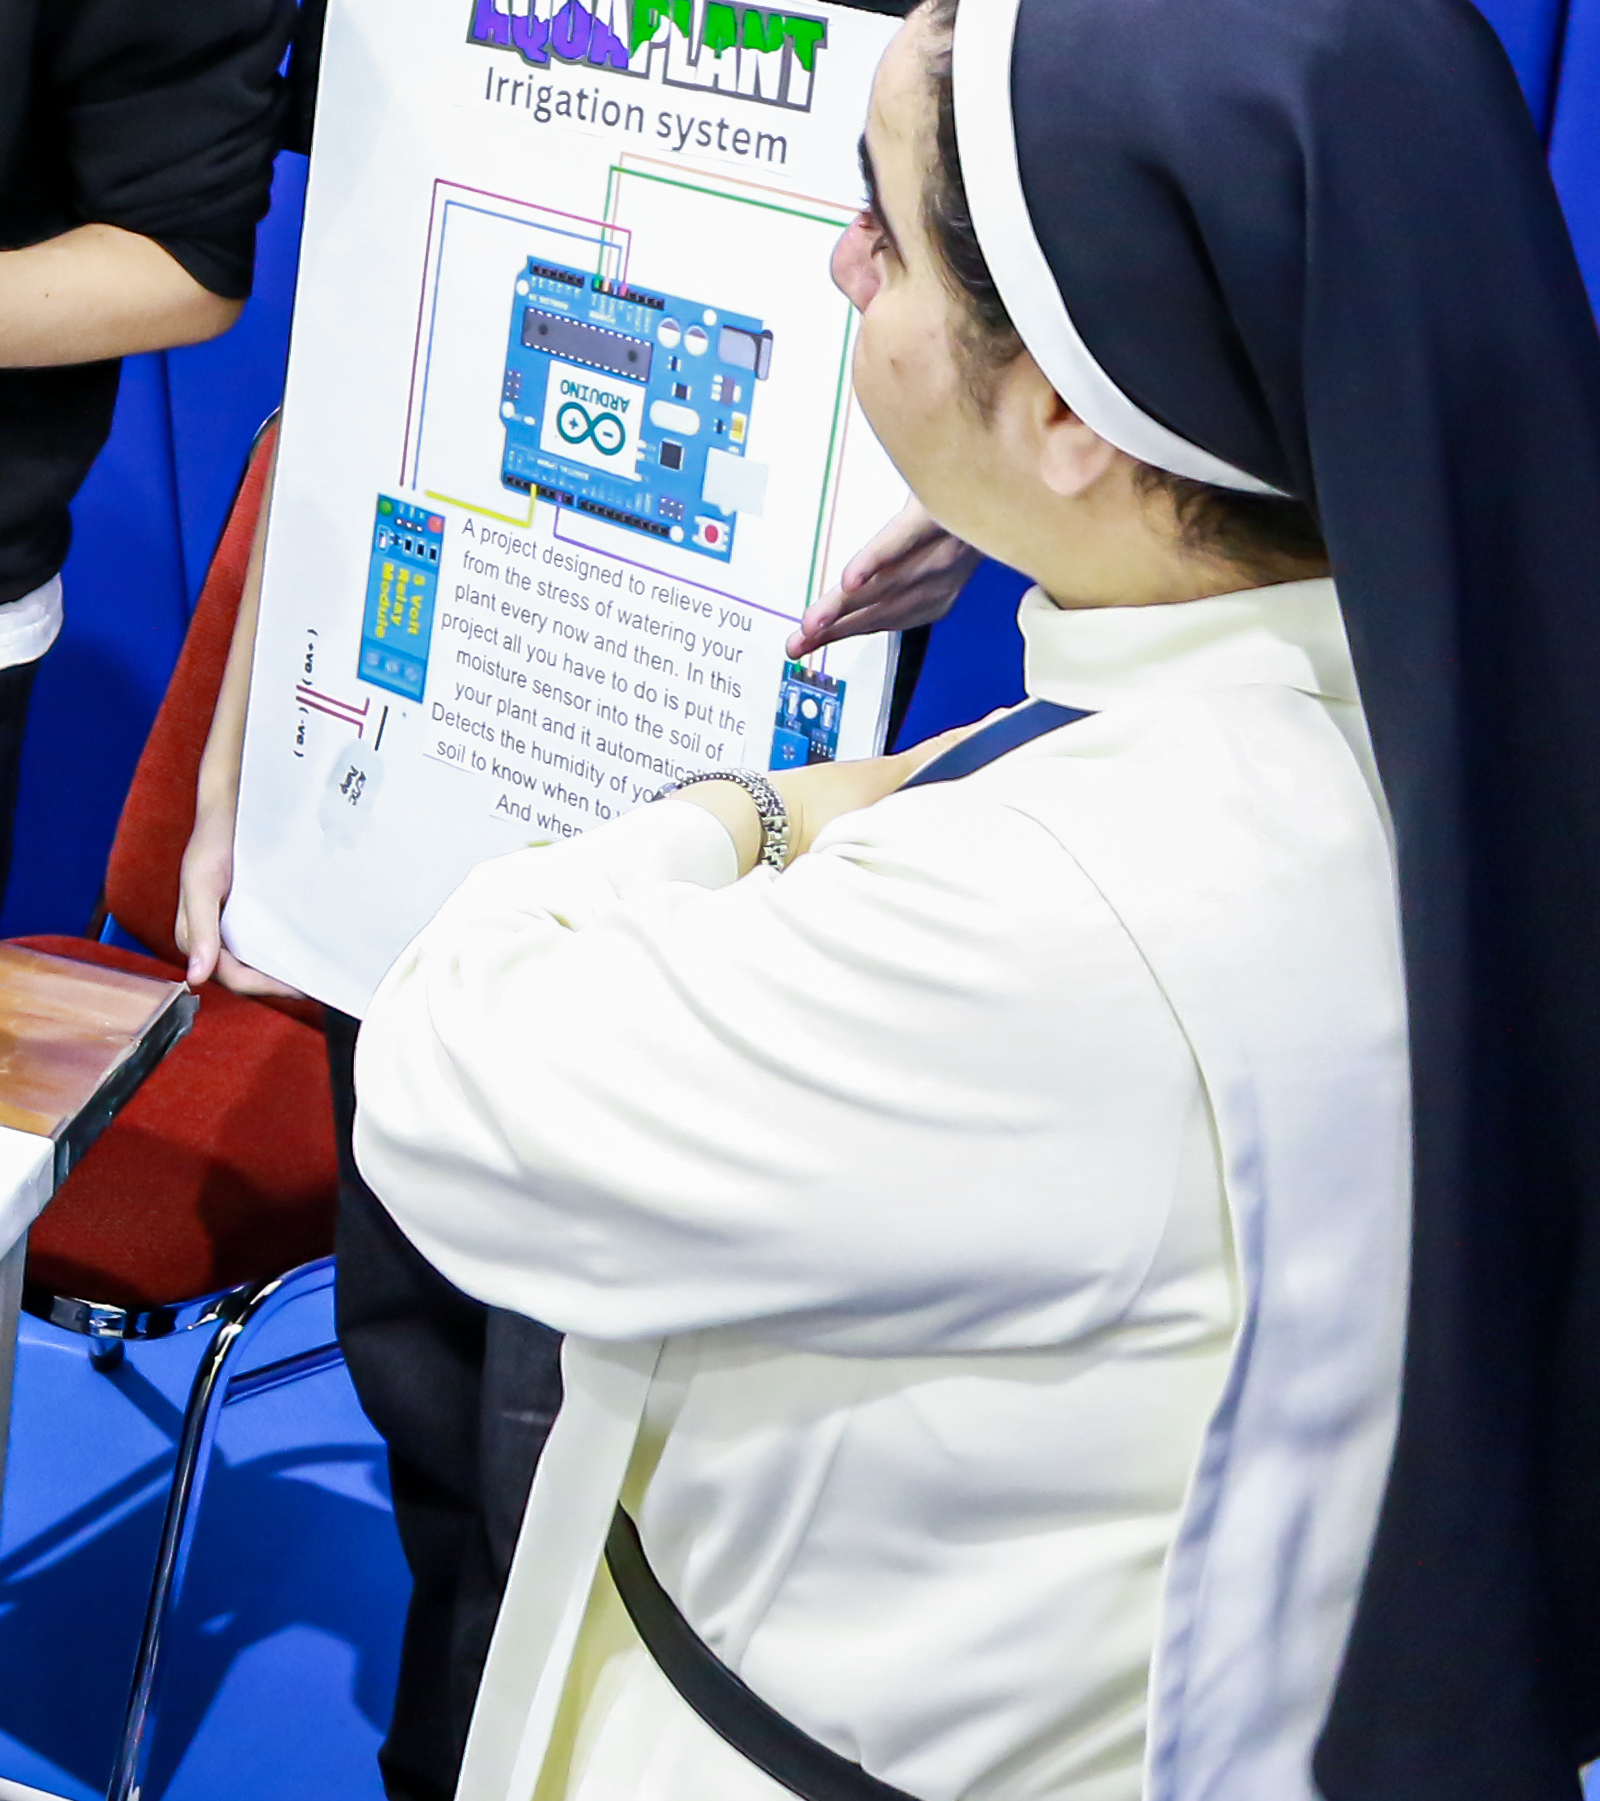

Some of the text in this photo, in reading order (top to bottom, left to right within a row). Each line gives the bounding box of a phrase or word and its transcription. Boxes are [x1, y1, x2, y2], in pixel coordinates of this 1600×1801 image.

[485, 66, 788, 164] Irrigation system
[560, 379, 630, 414] ARDUINO
[374, 561, 395, 639] Module
[389, 568, 411, 627] Relay
[406, 595, 423, 636] Volt
[462, 517, 752, 632] A project designed to relieve you
[462, 550, 743, 664] from the stress of watering your
[441, 612, 746, 737] project all you have to do is put the
[454, 582, 742, 699] plant every now and then. In this
[431, 701, 495, 741] Detects
[500, 728, 526, 754] the
[531, 740, 605, 788] humidity
[610, 774, 628, 797] of
[454, 681, 701, 782] your plant and it automatica
[456, 648, 724, 763] moisture sensor into the soil of
[436, 740, 612, 821] soil to know when to
[495, 793, 531, 823] And
